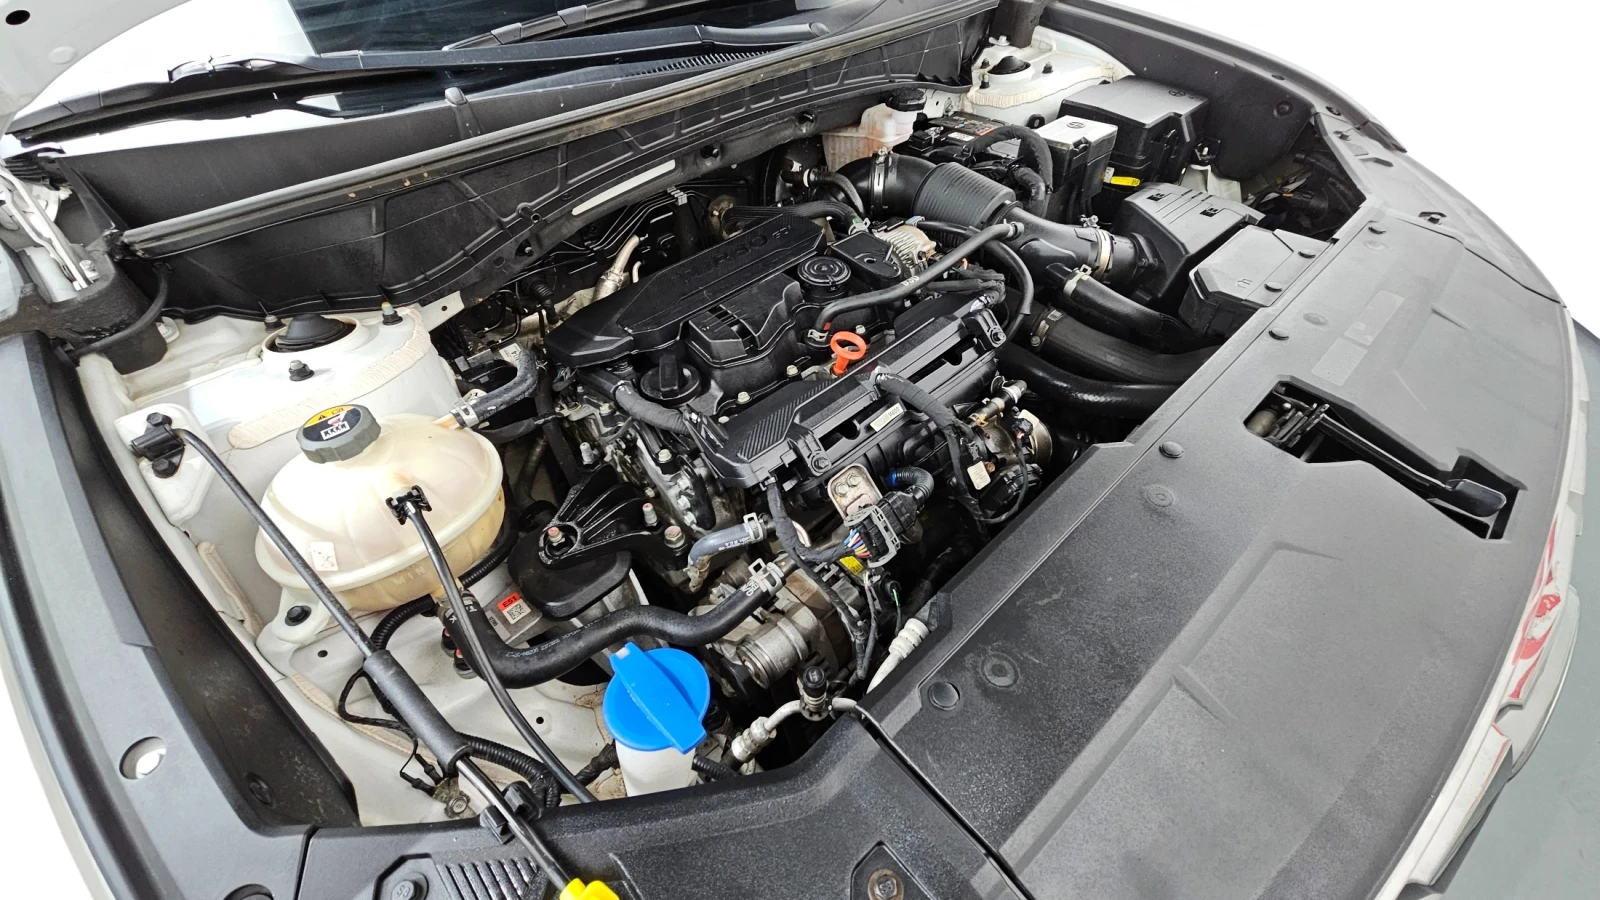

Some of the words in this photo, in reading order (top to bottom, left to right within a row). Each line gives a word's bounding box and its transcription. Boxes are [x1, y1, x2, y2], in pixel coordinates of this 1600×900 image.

[672, 234, 769, 283] TURBO
[392, 566, 427, 587] MIN
[502, 595, 517, 608] E51
